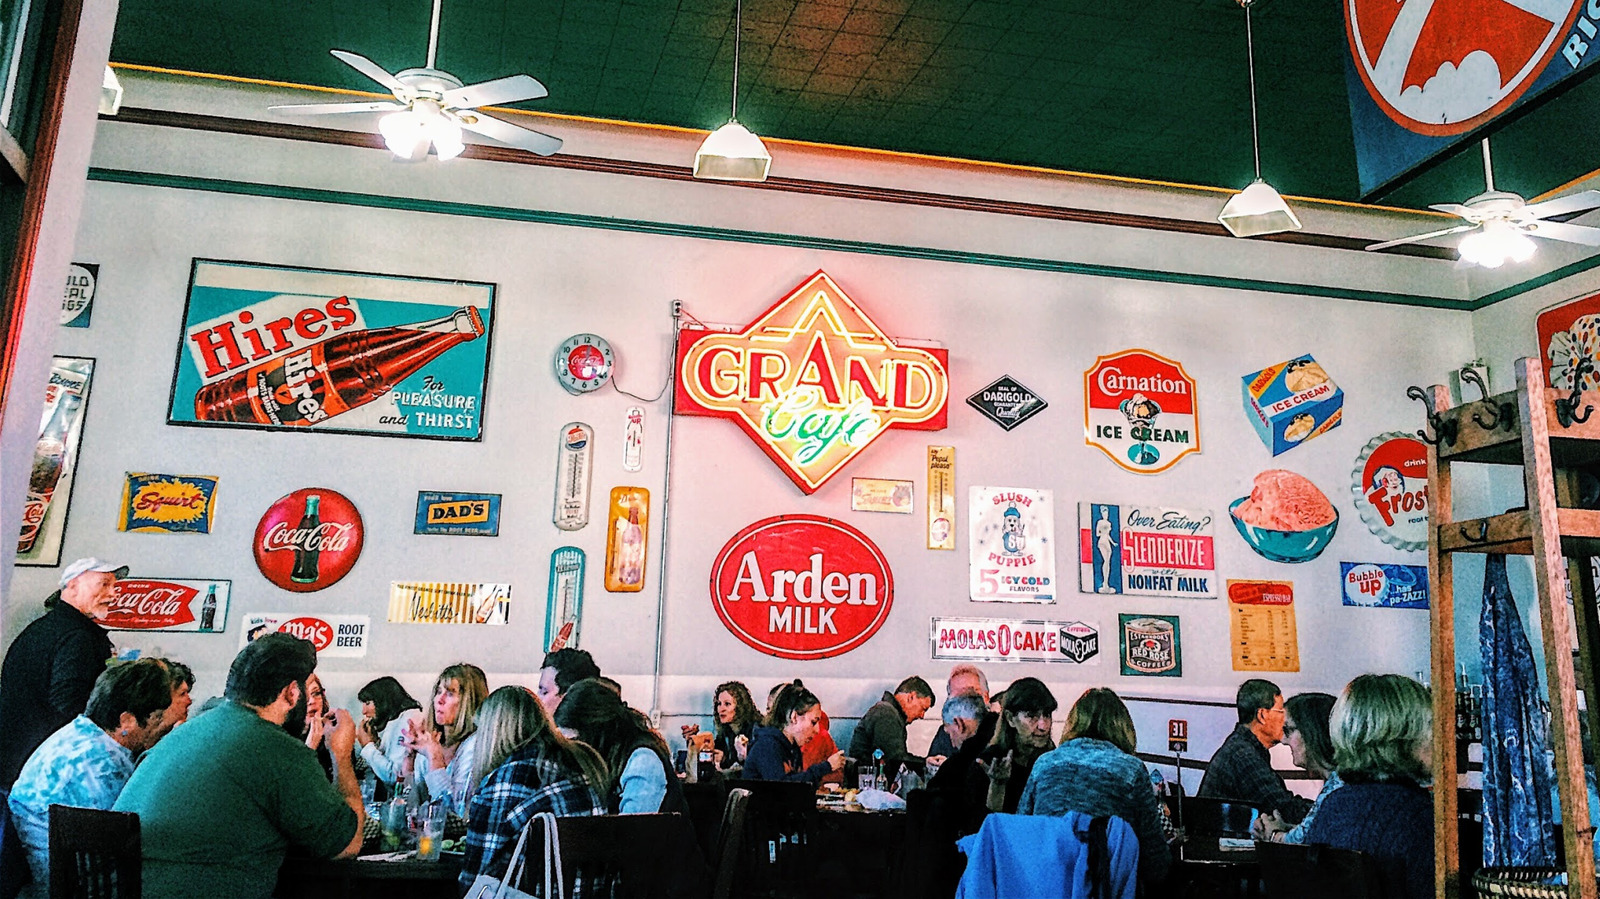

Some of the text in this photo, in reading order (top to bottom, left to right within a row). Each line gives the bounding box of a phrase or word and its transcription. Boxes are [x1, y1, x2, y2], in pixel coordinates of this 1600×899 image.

[191, 295, 357, 378] Hires
[584, 336, 591, 344] 12
[563, 346, 571, 354] 10
[605, 348, 610, 356] 2
[694, 330, 939, 412] GRAND
[284, 349, 329, 423] Hires
[422, 375, 445, 391] For
[571, 377, 577, 385] 7
[1097, 366, 1188, 396] Carnation
[1251, 367, 1276, 393] DARIGOLD
[391, 391, 476, 410] PLEASURE
[983, 391, 1032, 402] DARIGOLD
[1272, 400, 1293, 413] ICE
[1292, 384, 1330, 404] CREAM
[379, 412, 474, 429] and THIRST
[1096, 425, 1189, 443] ICE CREAM
[1404, 458, 1427, 467] drink
[136, 491, 204, 513] Squirt
[992, 492, 1033, 507] SLUSH
[432, 502, 484, 519] DAD'S
[1127, 509, 1211, 535] Over Eating?
[1408, 516, 1424, 524] root
[263, 521, 355, 552] Coca-Cola
[1121, 526, 1205, 573] SLENDERIZE
[988, 552, 1036, 567] PUPPIE
[726, 550, 878, 605] Arden
[979, 569, 1000, 596] 5
[1001, 576, 1050, 586] ICY COLD
[1127, 573, 1209, 593] NONFAT MILK
[1348, 569, 1384, 583] Bubble
[1359, 579, 1382, 596] up
[1389, 590, 1427, 606] pa-ZAZZ!
[768, 605, 838, 635] MILK
[338, 624, 365, 635] ROOT
[337, 636, 363, 647] BEER
[1132, 647, 1170, 660] RED ROSE
[1136, 660, 1166, 668] COFFEE
[1172, 721, 1184, 736] 31
